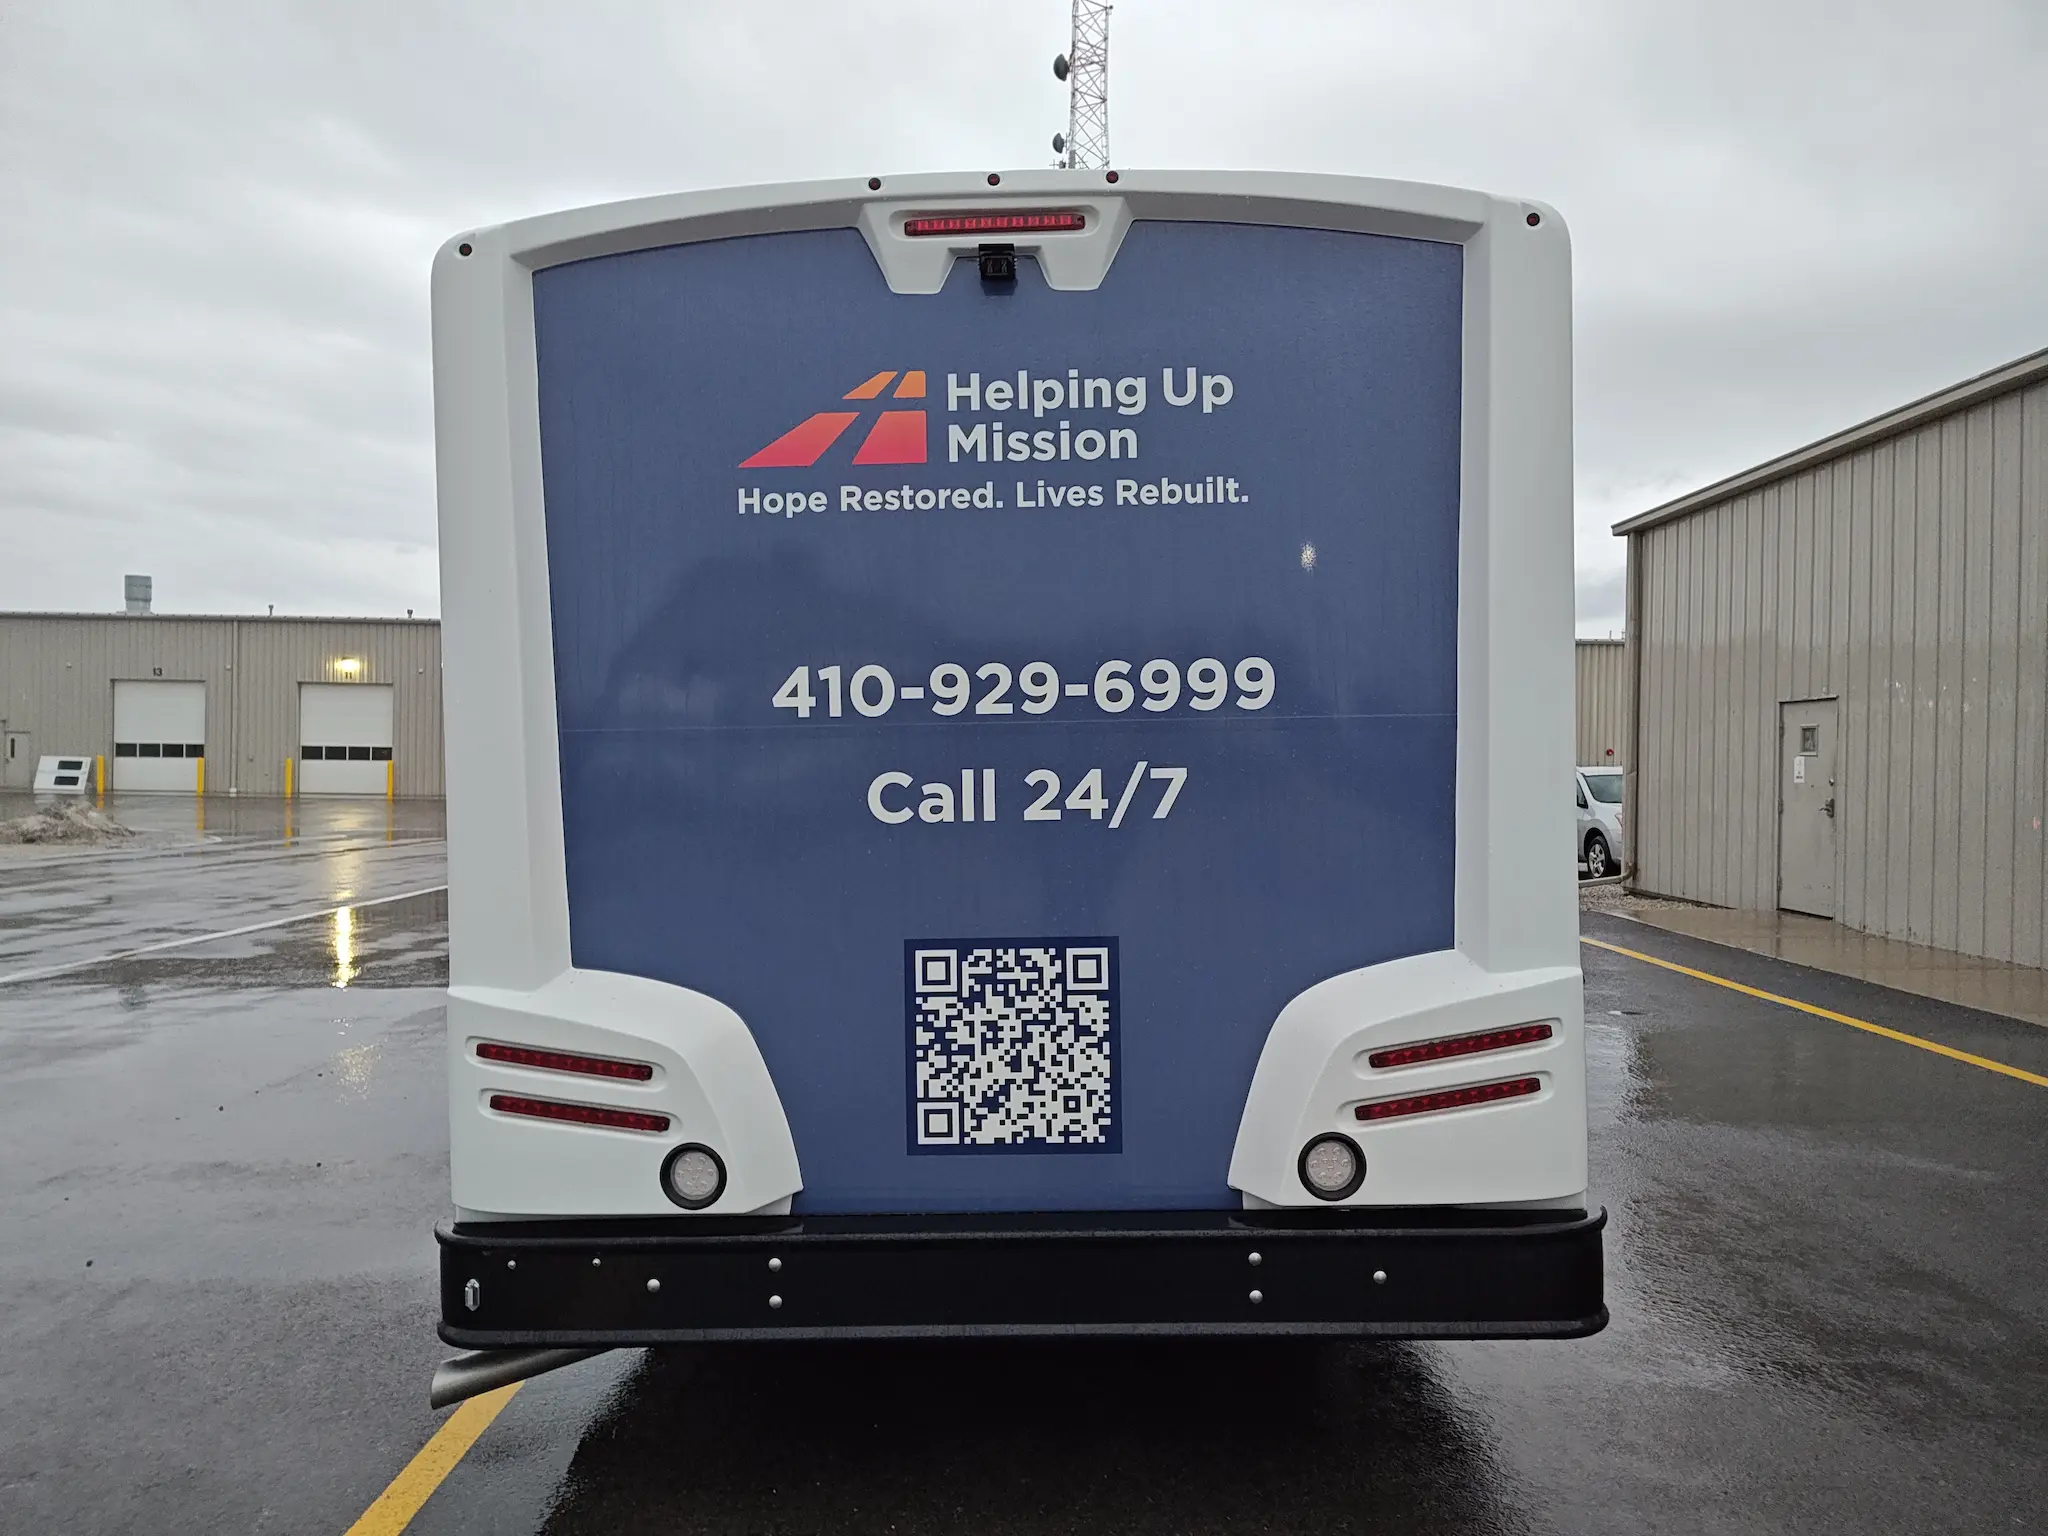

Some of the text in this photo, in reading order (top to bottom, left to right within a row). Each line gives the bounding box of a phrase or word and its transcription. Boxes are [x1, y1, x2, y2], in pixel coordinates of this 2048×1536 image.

[947, 366, 1234, 418] Helping Up
[948, 420, 1138, 463] Mission
[738, 476, 1249, 519] Hope Restored. Lives Rebuilt.
[152, 667, 163, 677] 13
[771, 656, 1276, 718] 410-929-6999
[867, 761, 1188, 829] Call 24/7
